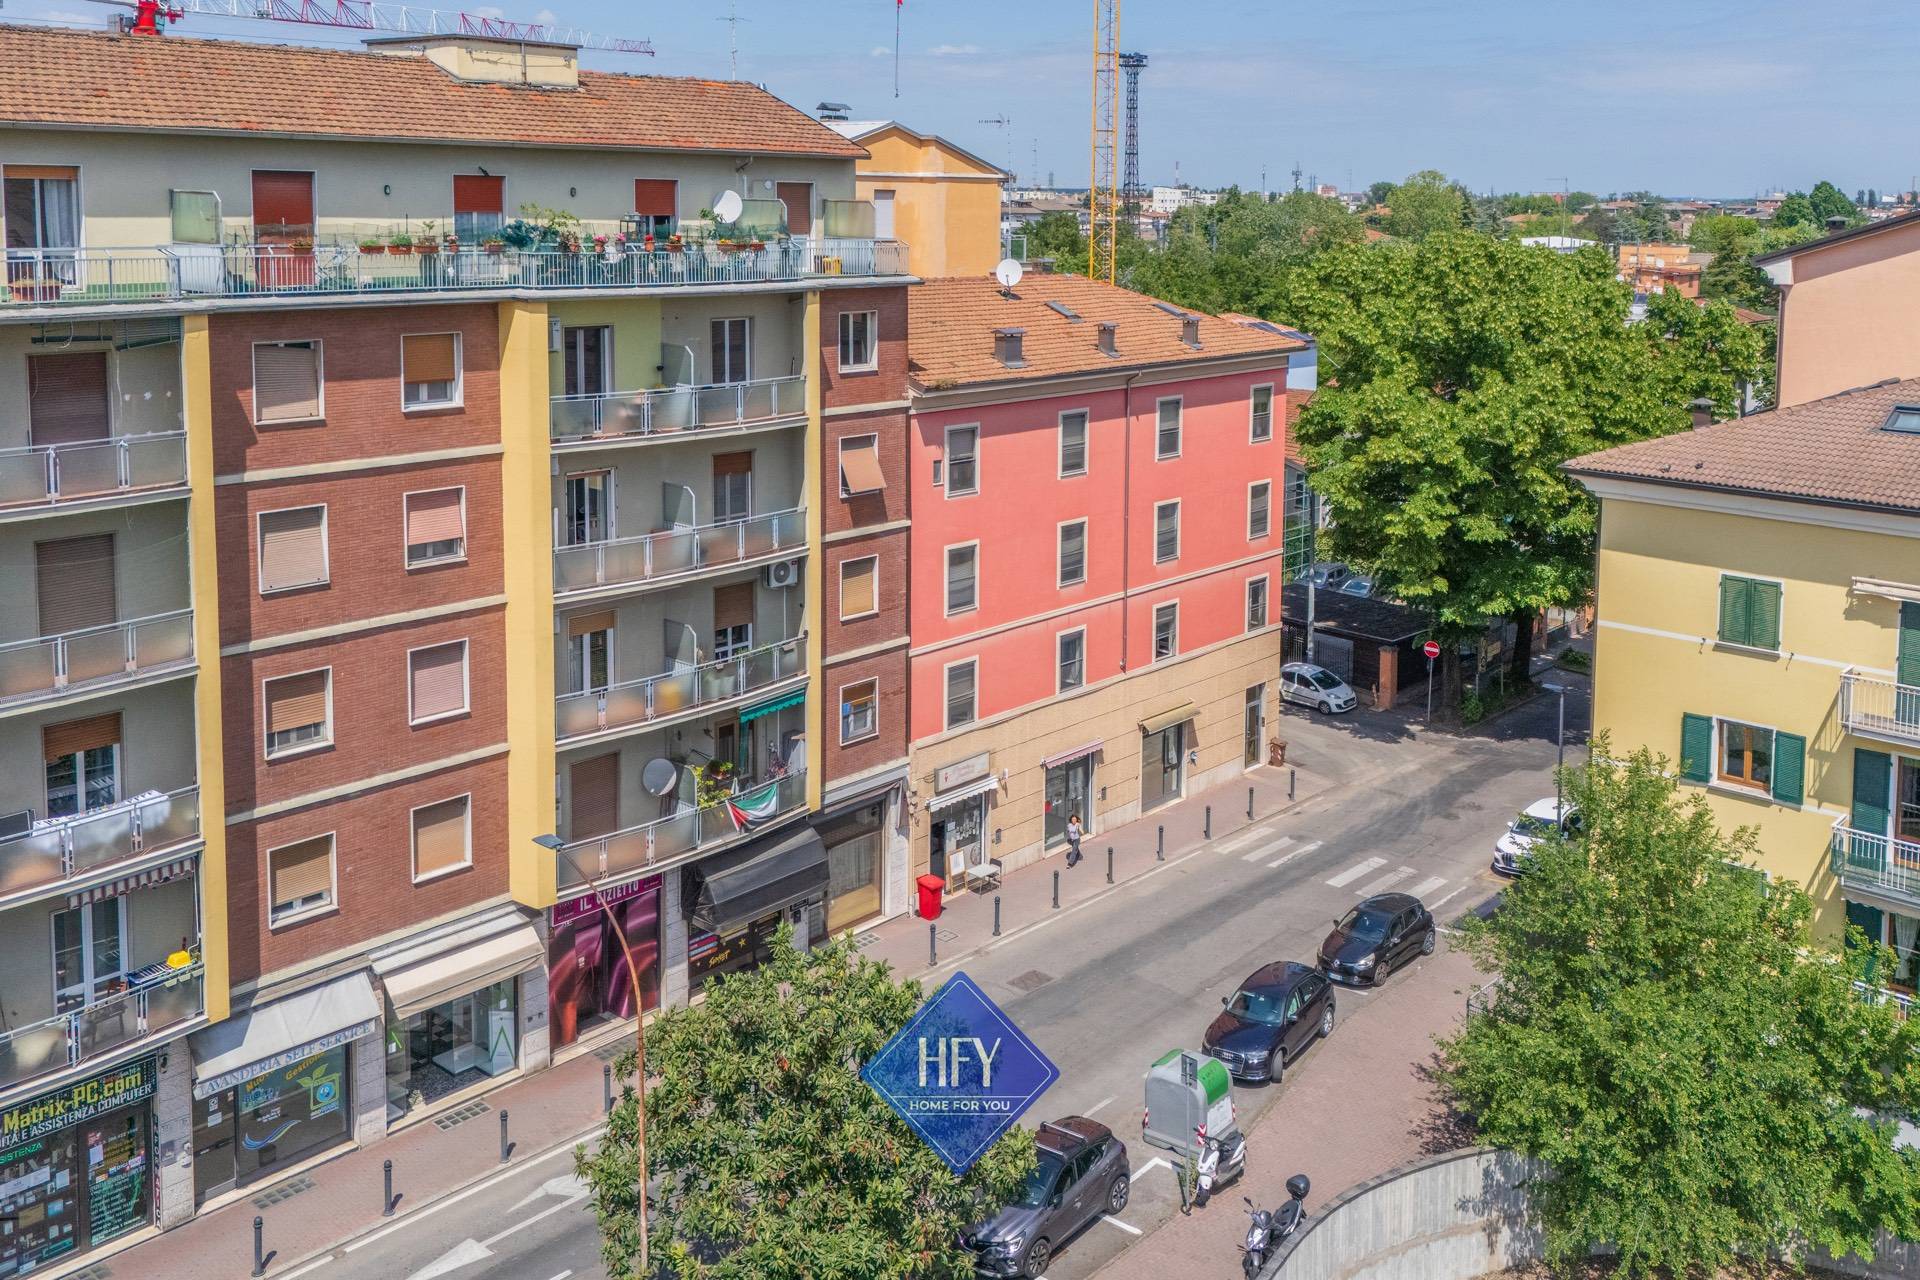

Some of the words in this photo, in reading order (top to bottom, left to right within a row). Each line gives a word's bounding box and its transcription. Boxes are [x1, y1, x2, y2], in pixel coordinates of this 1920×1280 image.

[580, 898, 592, 911] IL
[200, 1057, 281, 1096] LAVANDERIA
[286, 1044, 317, 1062] SELF
[320, 1023, 370, 1047] SERVICE
[4, 1072, 141, 1133] Matrix-PC.com
[22, 1129, 29, 1140] E
[30, 1106, 95, 1136] ASSISTENZA
[98, 1084, 152, 1111] COMPUTER
